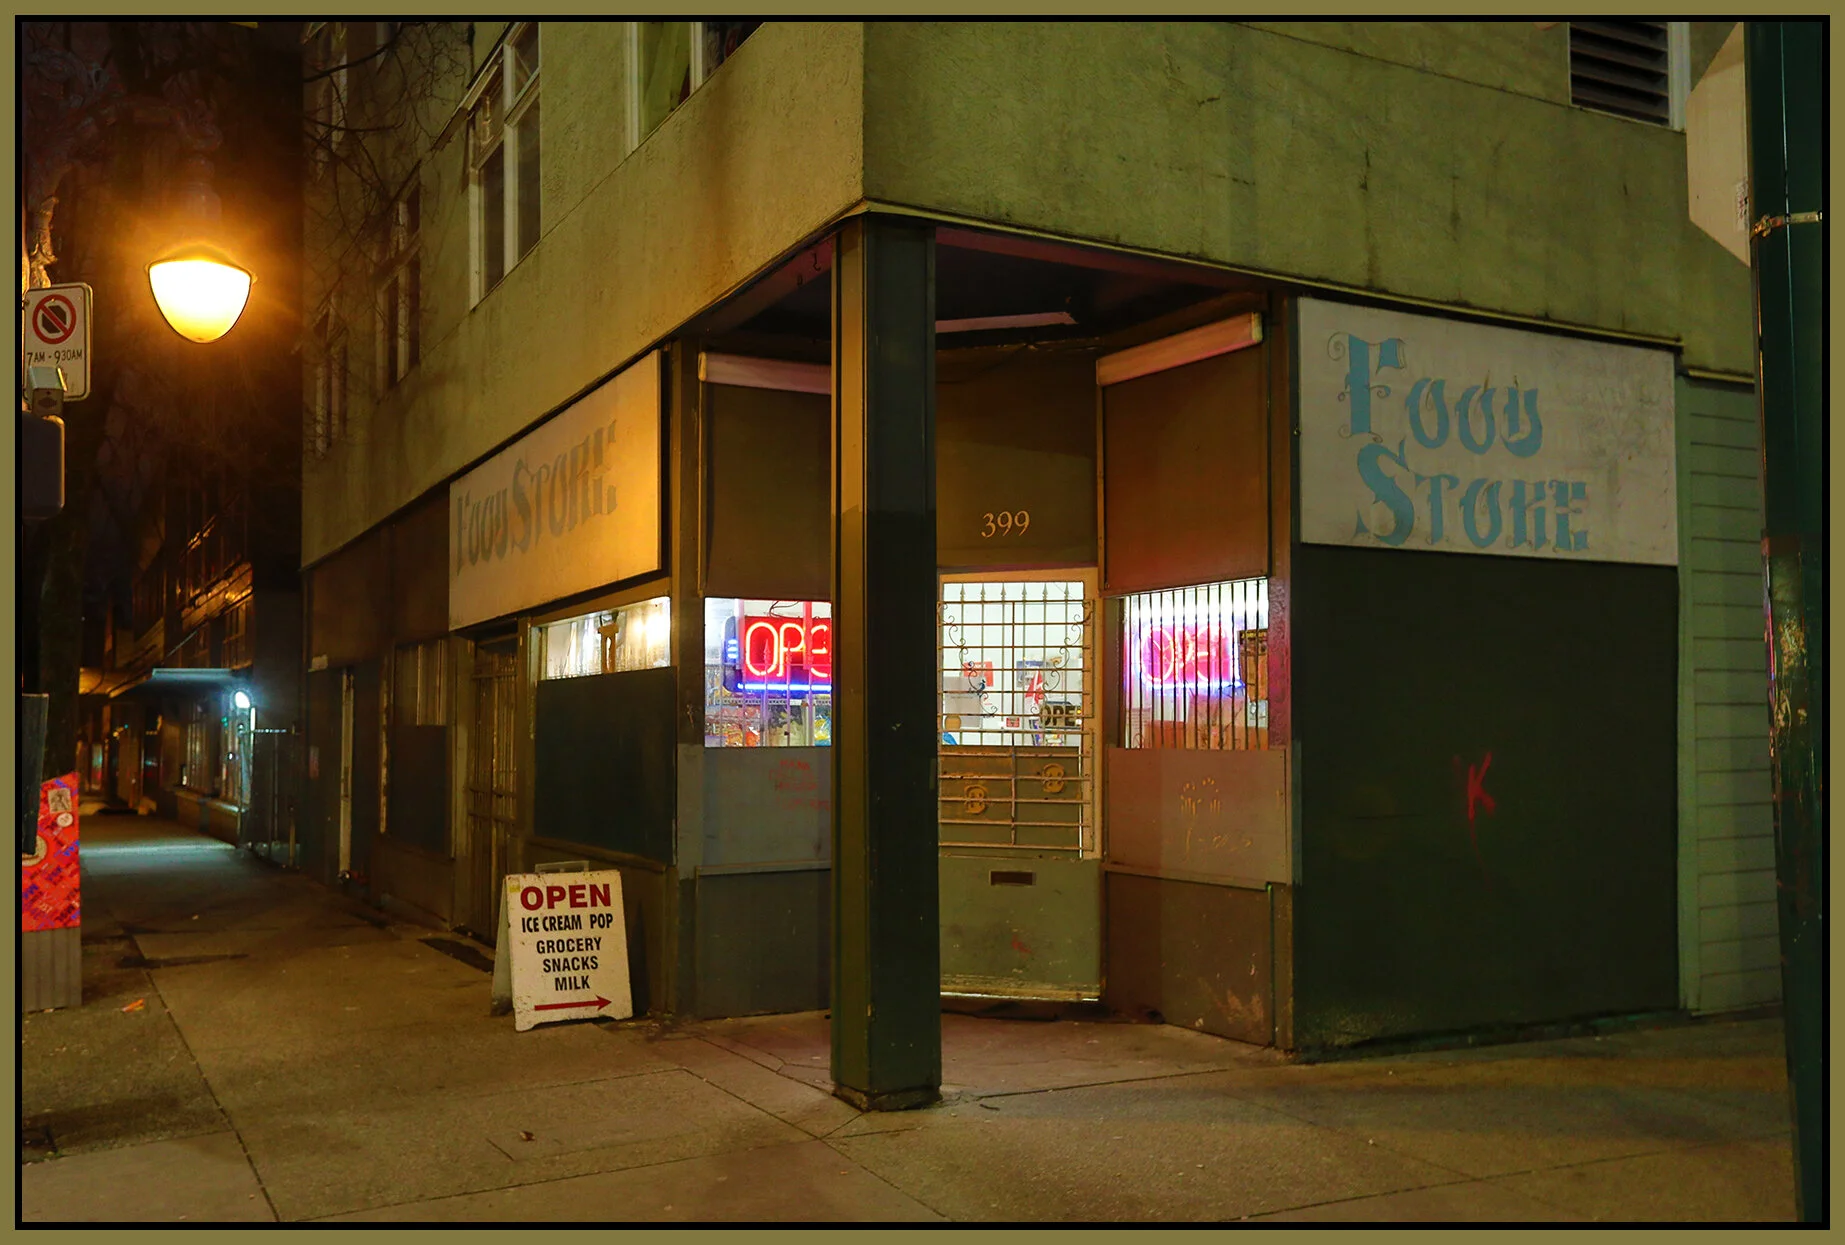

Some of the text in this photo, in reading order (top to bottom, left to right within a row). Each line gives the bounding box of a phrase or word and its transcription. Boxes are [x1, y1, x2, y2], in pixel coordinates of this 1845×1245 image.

[27, 352, 45, 366] 7AM
[981, 510, 1031, 539] 399
[745, 621, 832, 679] OPE
[520, 883, 612, 911] OPEN
[522, 913, 614, 933] ICE CREAM POP
[536, 937, 602, 954] GROCERY
[543, 956, 599, 973] SNACKS
[554, 975, 591, 991] MILK
